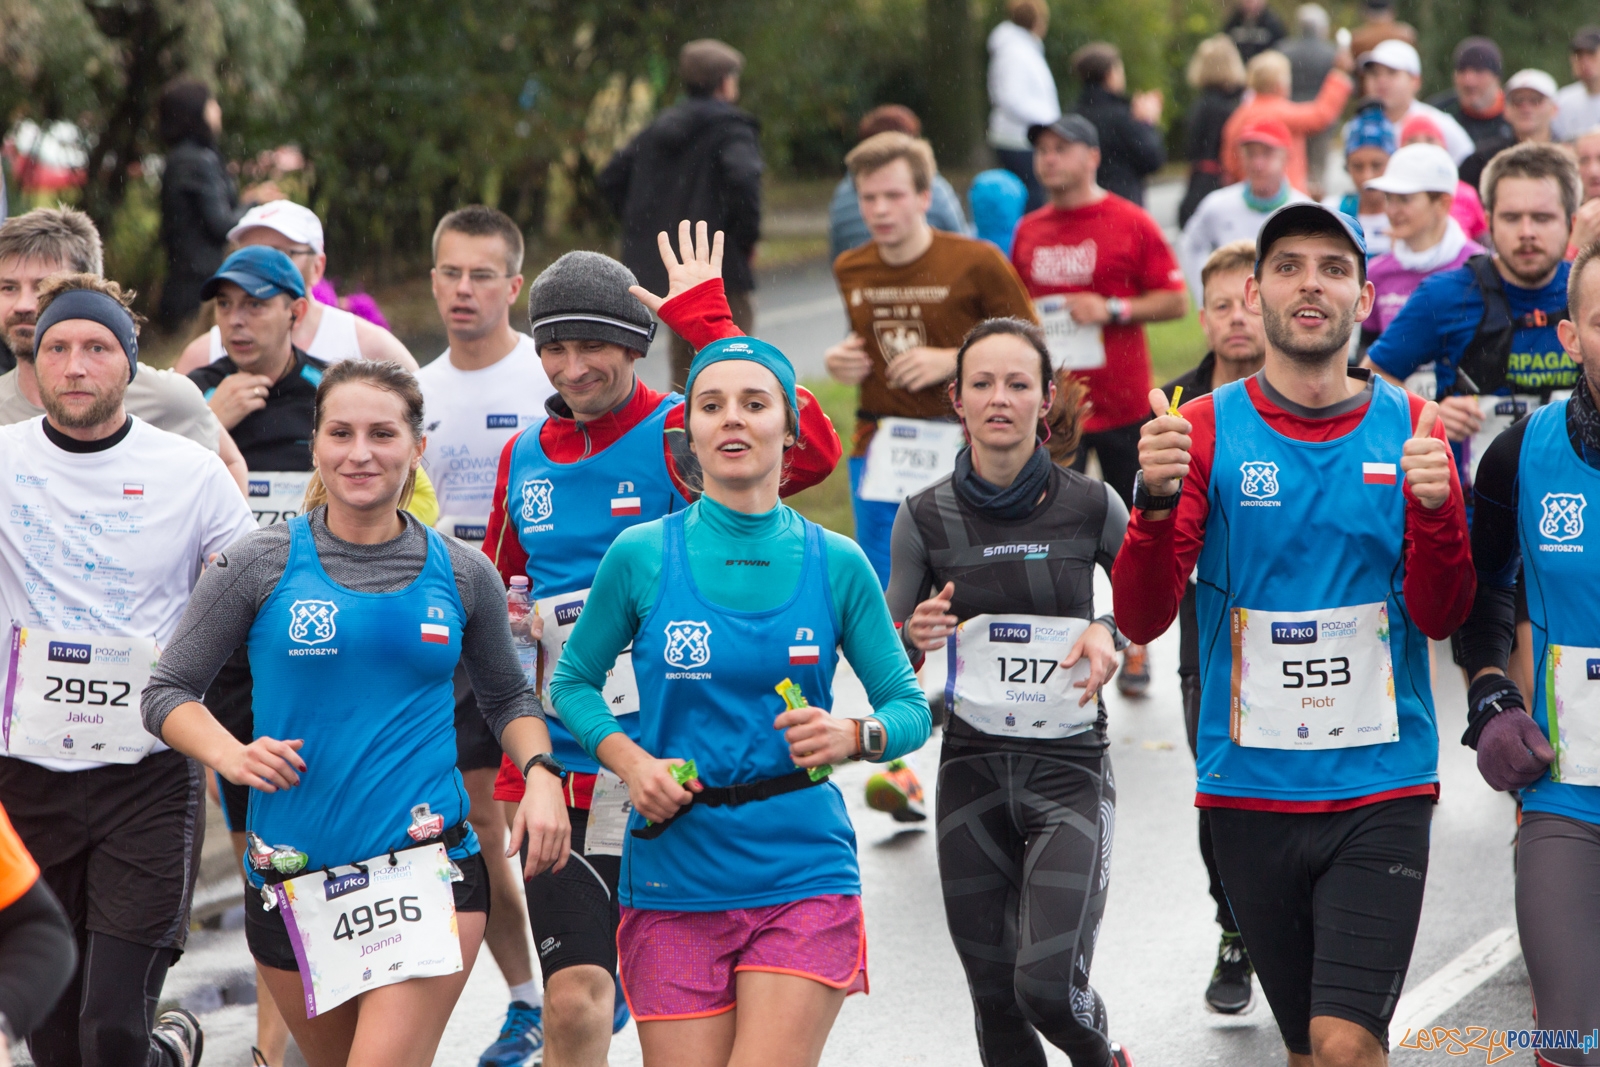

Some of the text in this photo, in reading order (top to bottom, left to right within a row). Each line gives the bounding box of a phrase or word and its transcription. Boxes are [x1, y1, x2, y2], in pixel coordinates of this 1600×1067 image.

[524, 524, 554, 534] KROTOSZYN
[983, 544, 1050, 557] SMMASH
[1540, 544, 1584, 552] KROTOSZYN
[1034, 634, 1068, 643] maraton
[1322, 627, 1357, 638] maraton
[288, 648, 338, 656] KROTOSZYN
[94, 654, 130, 663] maraton
[666, 672, 712, 680] KROTOSZYN
[997, 657, 1058, 684] 1217
[1282, 656, 1351, 688] 553
[44, 676, 130, 706] 2952
[1006, 690, 1046, 704] Sylwia
[1302, 695, 1335, 708] Piotr
[65, 712, 104, 724] Jakub
[333, 896, 422, 940] 4956
[360, 934, 402, 958] Joanna
